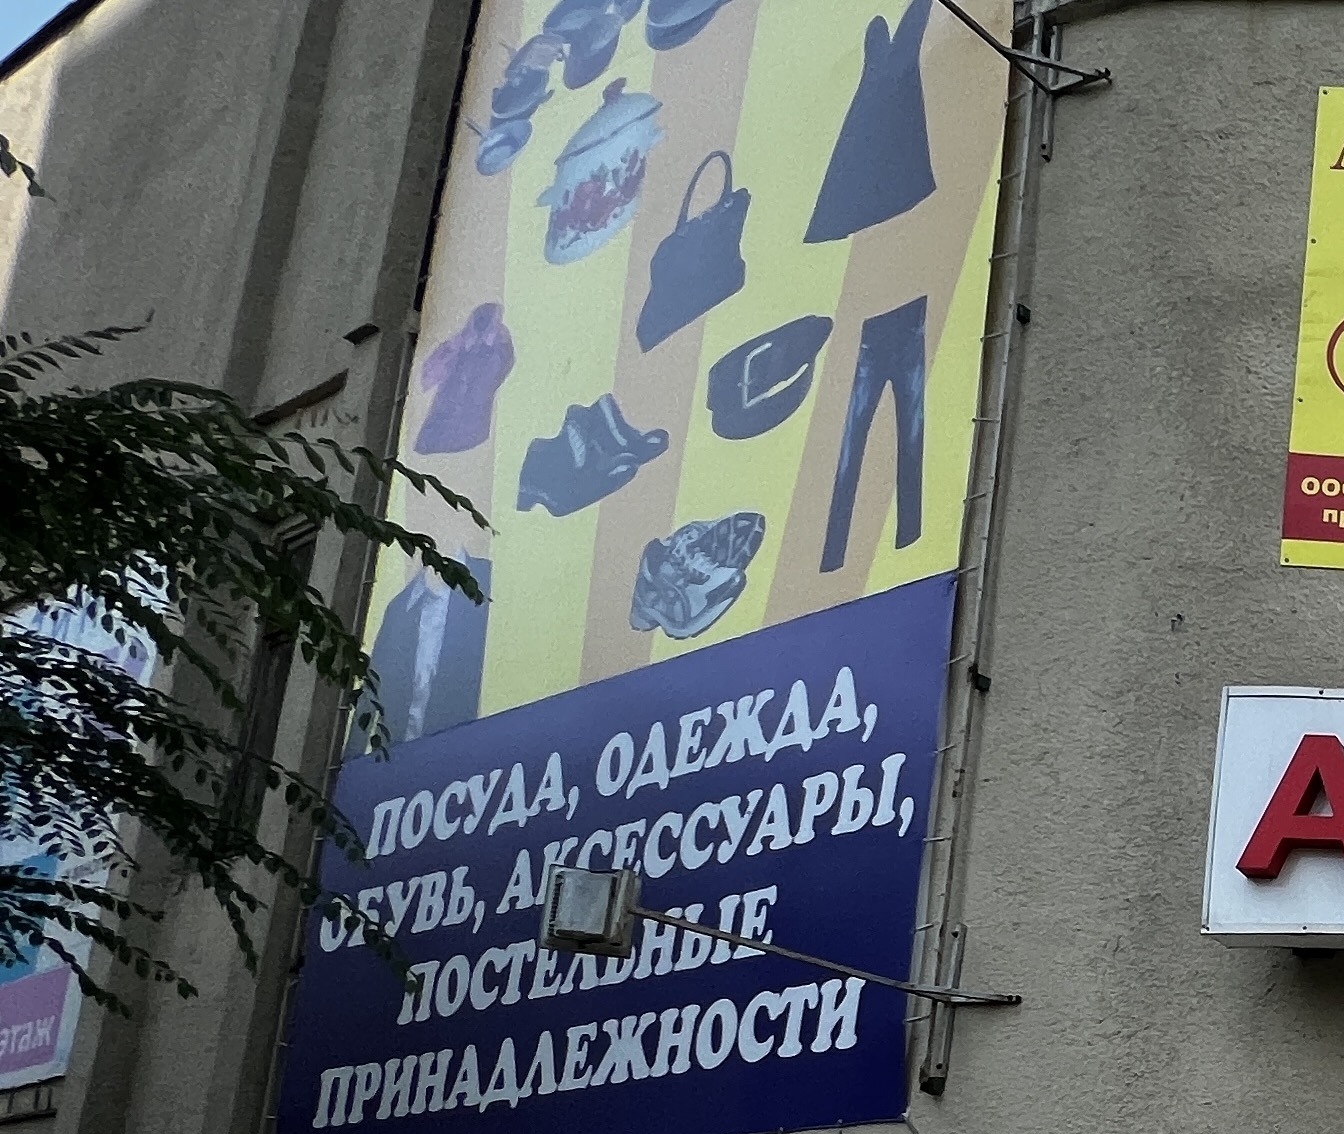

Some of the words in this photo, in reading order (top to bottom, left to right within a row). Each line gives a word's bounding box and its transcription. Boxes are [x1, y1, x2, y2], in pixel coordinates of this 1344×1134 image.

[365, 752, 579, 861] ПОСУДА,
[596, 667, 878, 799] ОДЕЖДА,
[320, 866, 486, 951] ОБУВЬ,
[312, 978, 866, 1128] ПРИНАДЛЕЖНОСТИ
